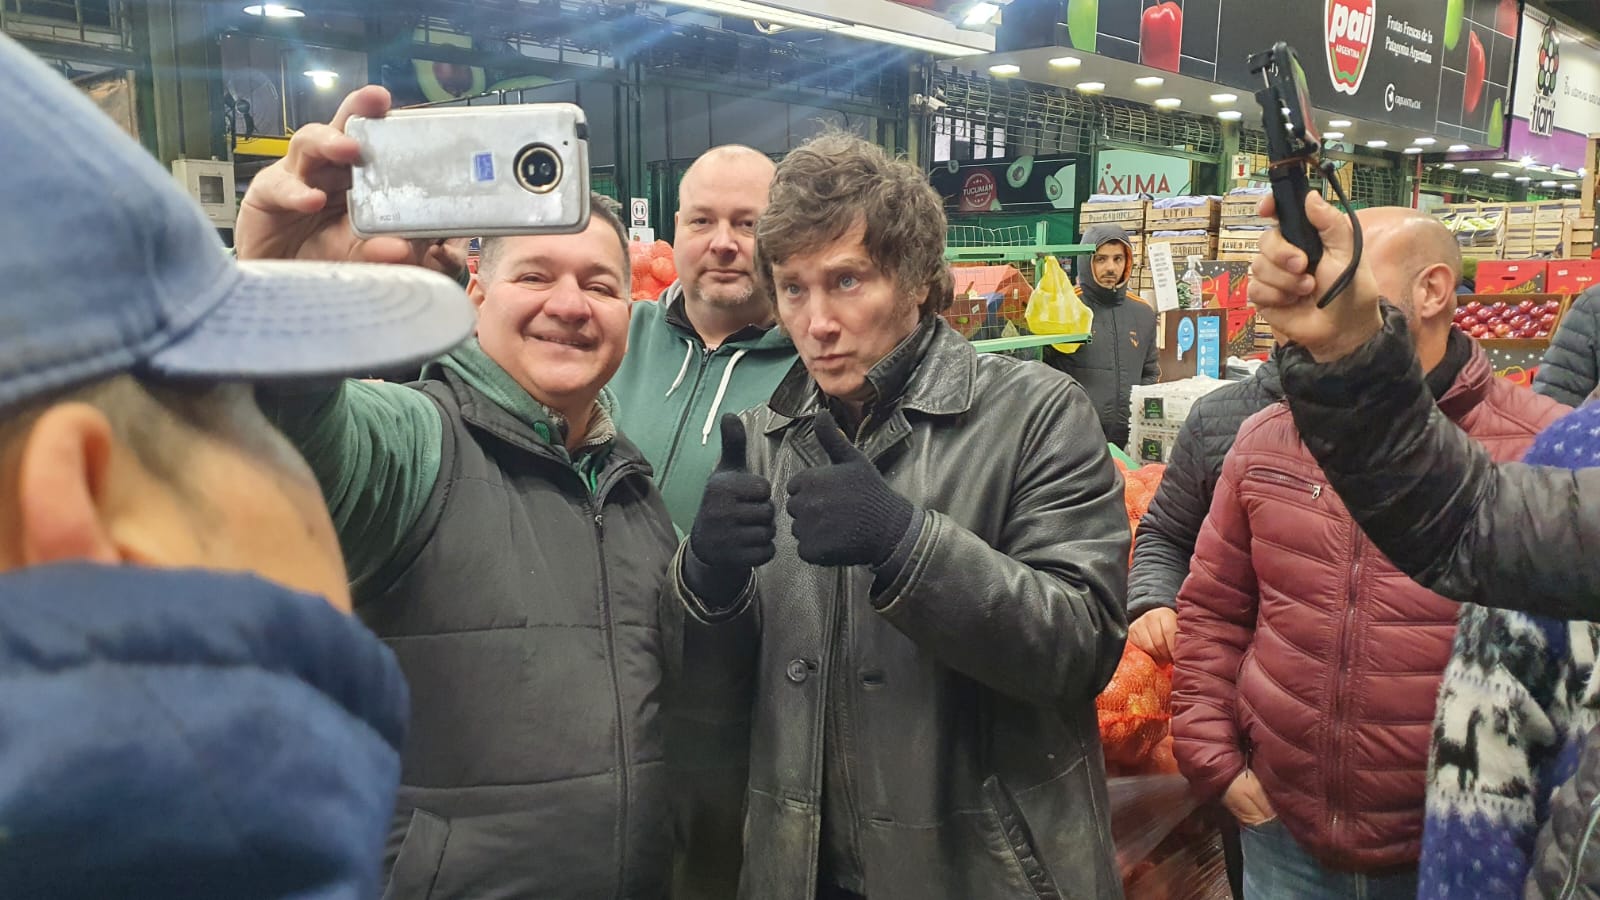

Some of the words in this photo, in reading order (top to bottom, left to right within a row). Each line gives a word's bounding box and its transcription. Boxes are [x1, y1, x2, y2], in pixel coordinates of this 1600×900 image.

[1329, 3, 1373, 44] pai
[1386, 15, 1403, 32] Frutas
[1403, 21, 1422, 40] Frescas
[1421, 28, 1428, 42] de
[1427, 30, 1433, 44] la
[1335, 44, 1360, 59] ARGENTINA
[1385, 35, 1410, 57] Patagonia
[1409, 45, 1432, 64] Argentina
